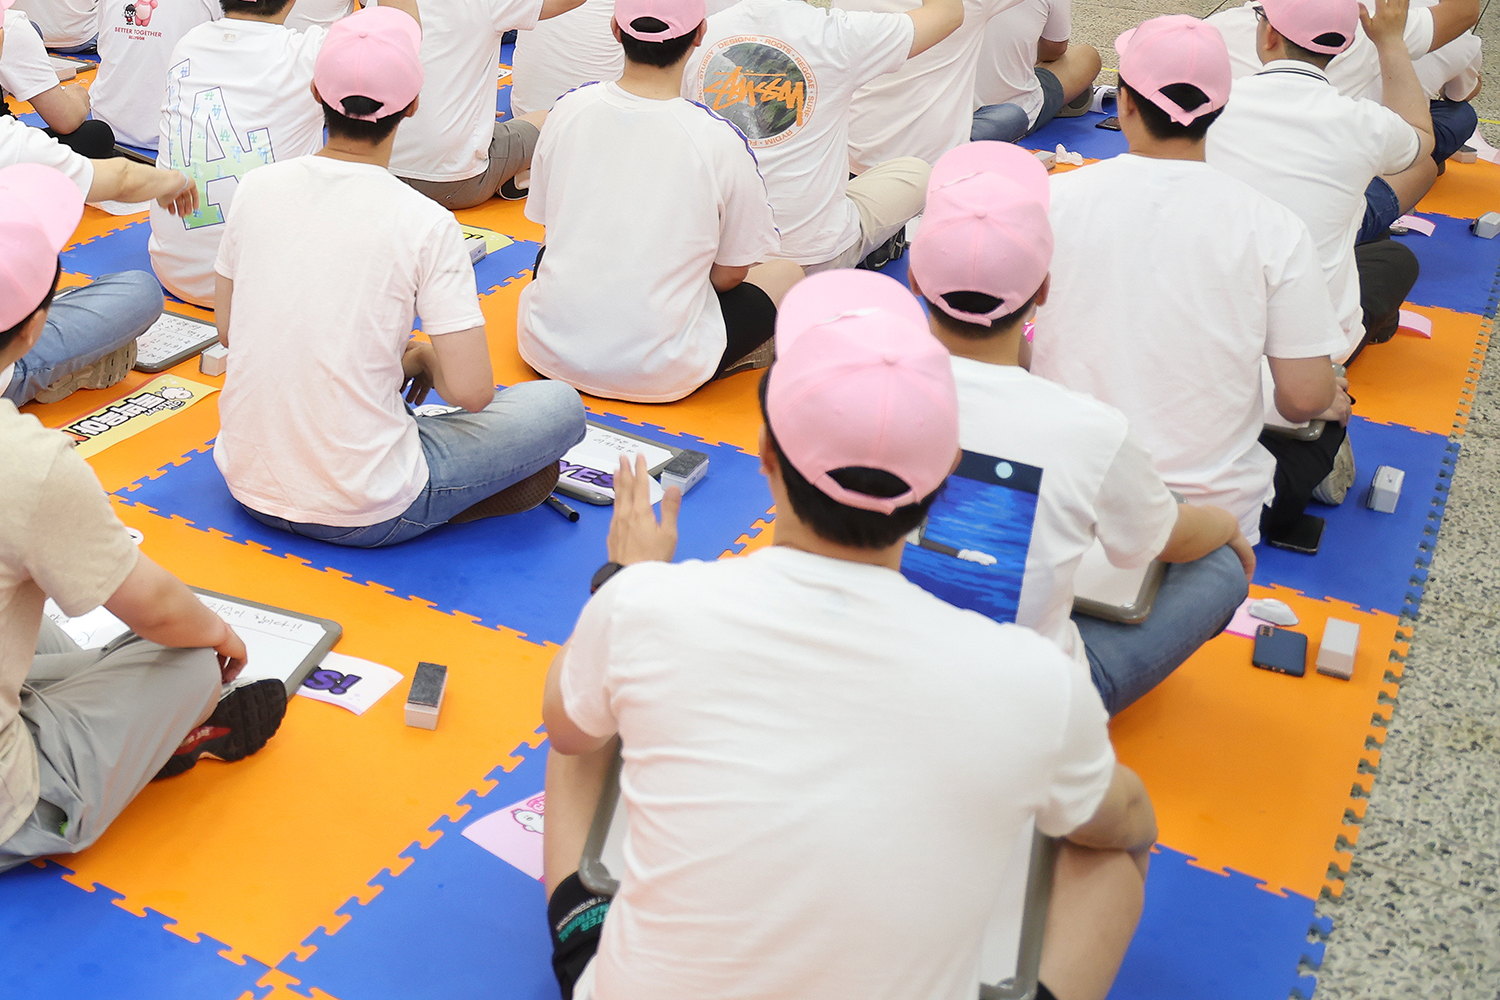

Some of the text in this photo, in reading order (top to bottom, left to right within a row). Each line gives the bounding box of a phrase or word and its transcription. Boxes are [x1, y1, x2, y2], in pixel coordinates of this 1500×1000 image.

[114, 27, 163, 38] BETTER TOGETHER
[717, 36, 758, 49] DESIGNS
[764, 39, 793, 54] ROOTS
[794, 56, 815, 89] REGGAE
[804, 95, 815, 119] SURF
